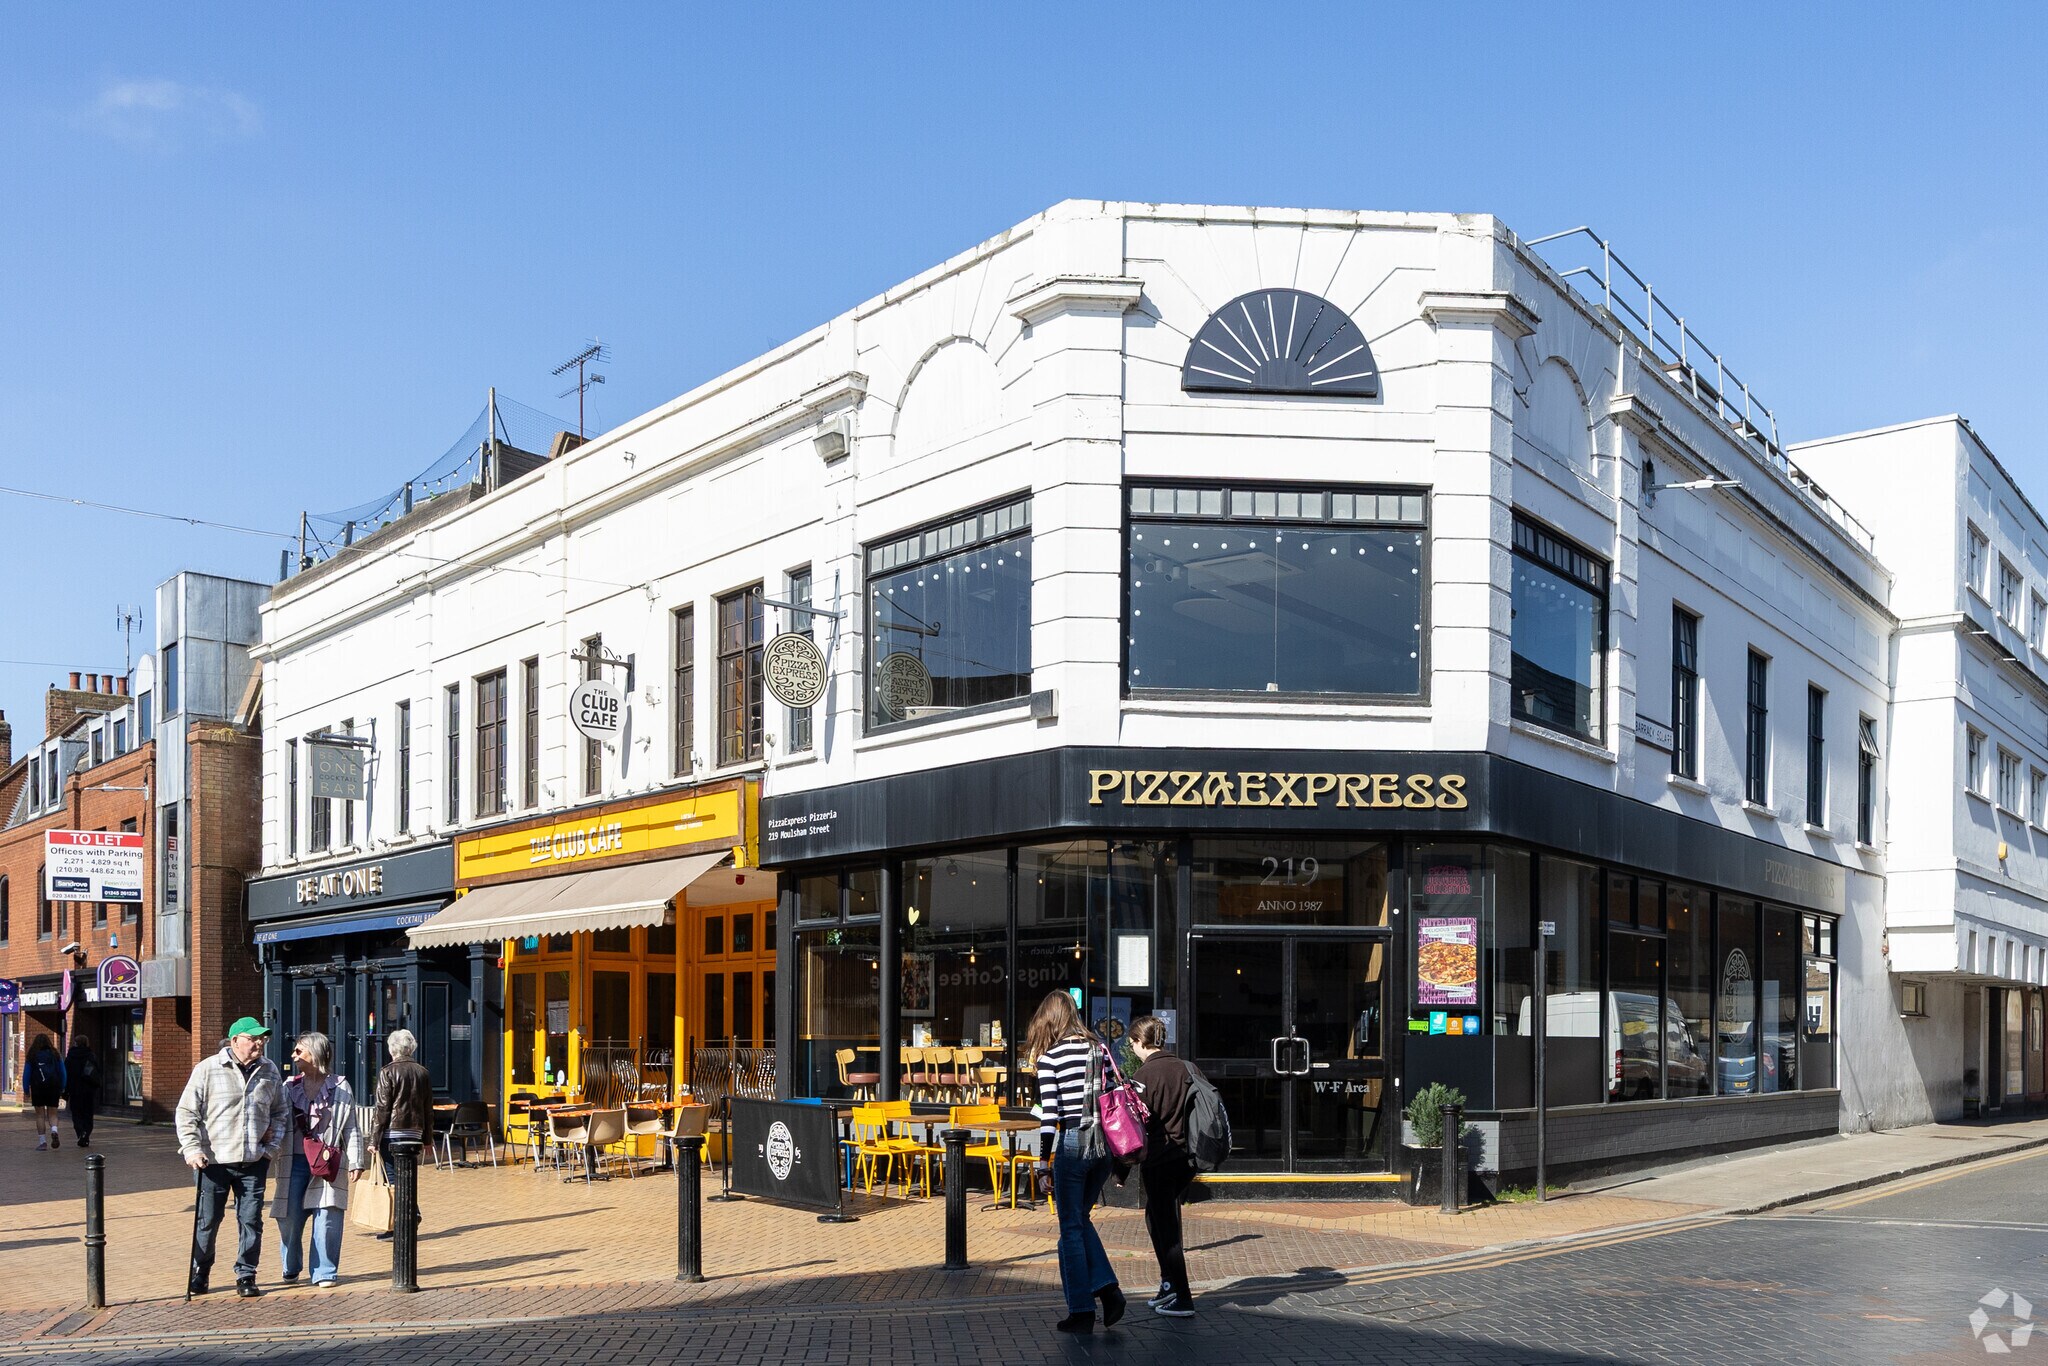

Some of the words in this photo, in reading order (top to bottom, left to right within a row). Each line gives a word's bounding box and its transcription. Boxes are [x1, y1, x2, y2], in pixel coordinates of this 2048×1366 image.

[781, 658, 810, 671] PIZZA
[773, 665, 818, 681] EXPRESS
[593, 688, 608, 697] THE
[581, 693, 613, 713] CLUB
[581, 709, 617, 728] CAFE
[320, 751, 335, 761] BE
[320, 761, 357, 776] ONE
[319, 774, 357, 783] COCKTAIL
[320, 782, 356, 796] BAR
[1088, 770, 1468, 809] PIZZAEXPRESS
[768, 816, 807, 829] PizzaExpress
[809, 810, 838, 822] Pizzeria
[70, 833, 91, 845] TO
[95, 834, 123, 846] LET
[768, 831, 779, 841] 219
[780, 828, 807, 839] Moulsham
[809, 824, 830, 835] Street
[530, 836, 551, 854] THE
[553, 829, 586, 860] CLUB
[588, 822, 622, 854] CAFE
[50, 847, 83, 855] Offices
[108, 849, 143, 859] Parking
[1260, 856, 1319, 887] 219
[343, 865, 383, 896] ONE
[1257, 900, 1297, 911] ANNO
[1299, 901, 1323, 912] 1987
[396, 914, 423, 926] COCKTAIL
[1345, 1081, 1370, 1093] Area
